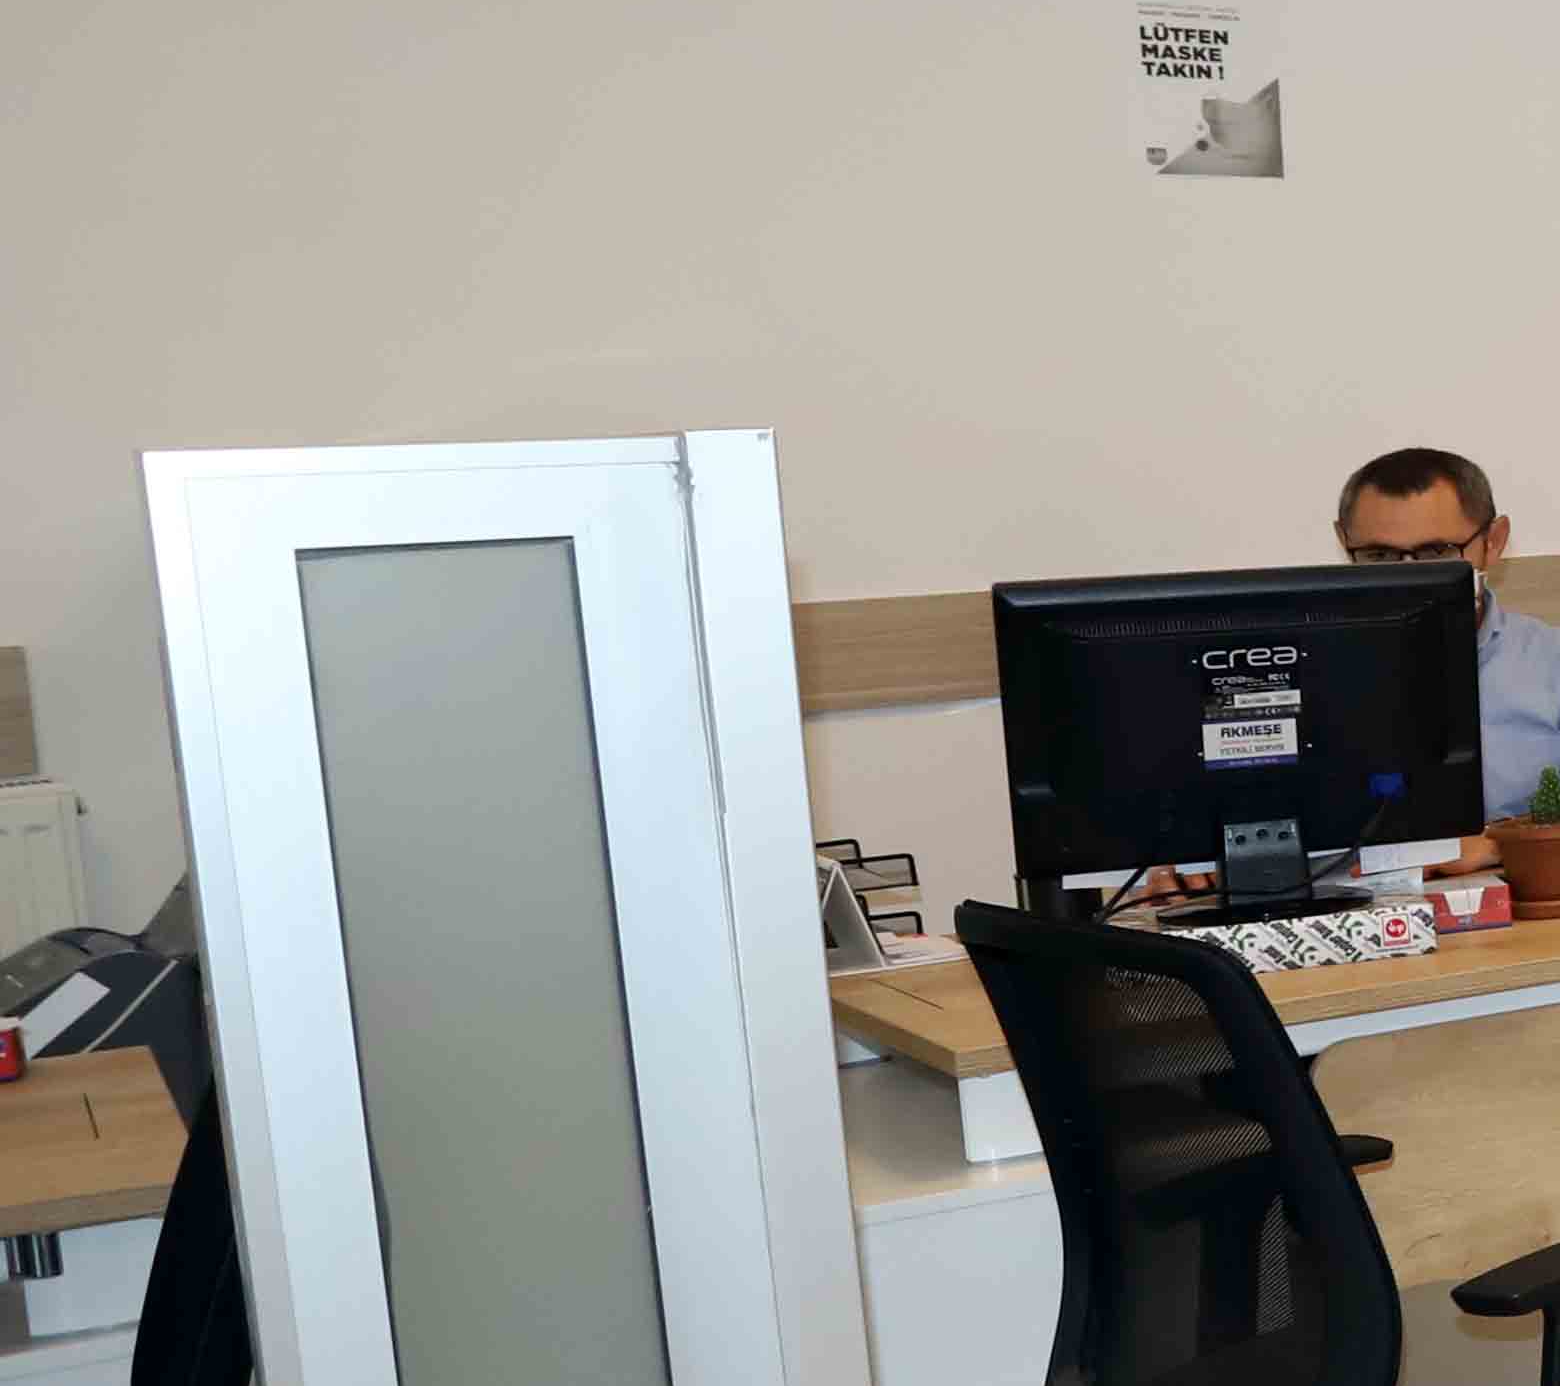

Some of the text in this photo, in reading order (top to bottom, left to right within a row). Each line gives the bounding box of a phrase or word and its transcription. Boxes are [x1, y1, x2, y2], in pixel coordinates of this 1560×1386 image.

[1139, 22, 1229, 45] LÜTFEN
[1141, 43, 1222, 62] MASKE
[1202, 646, 1297, 669] crea
